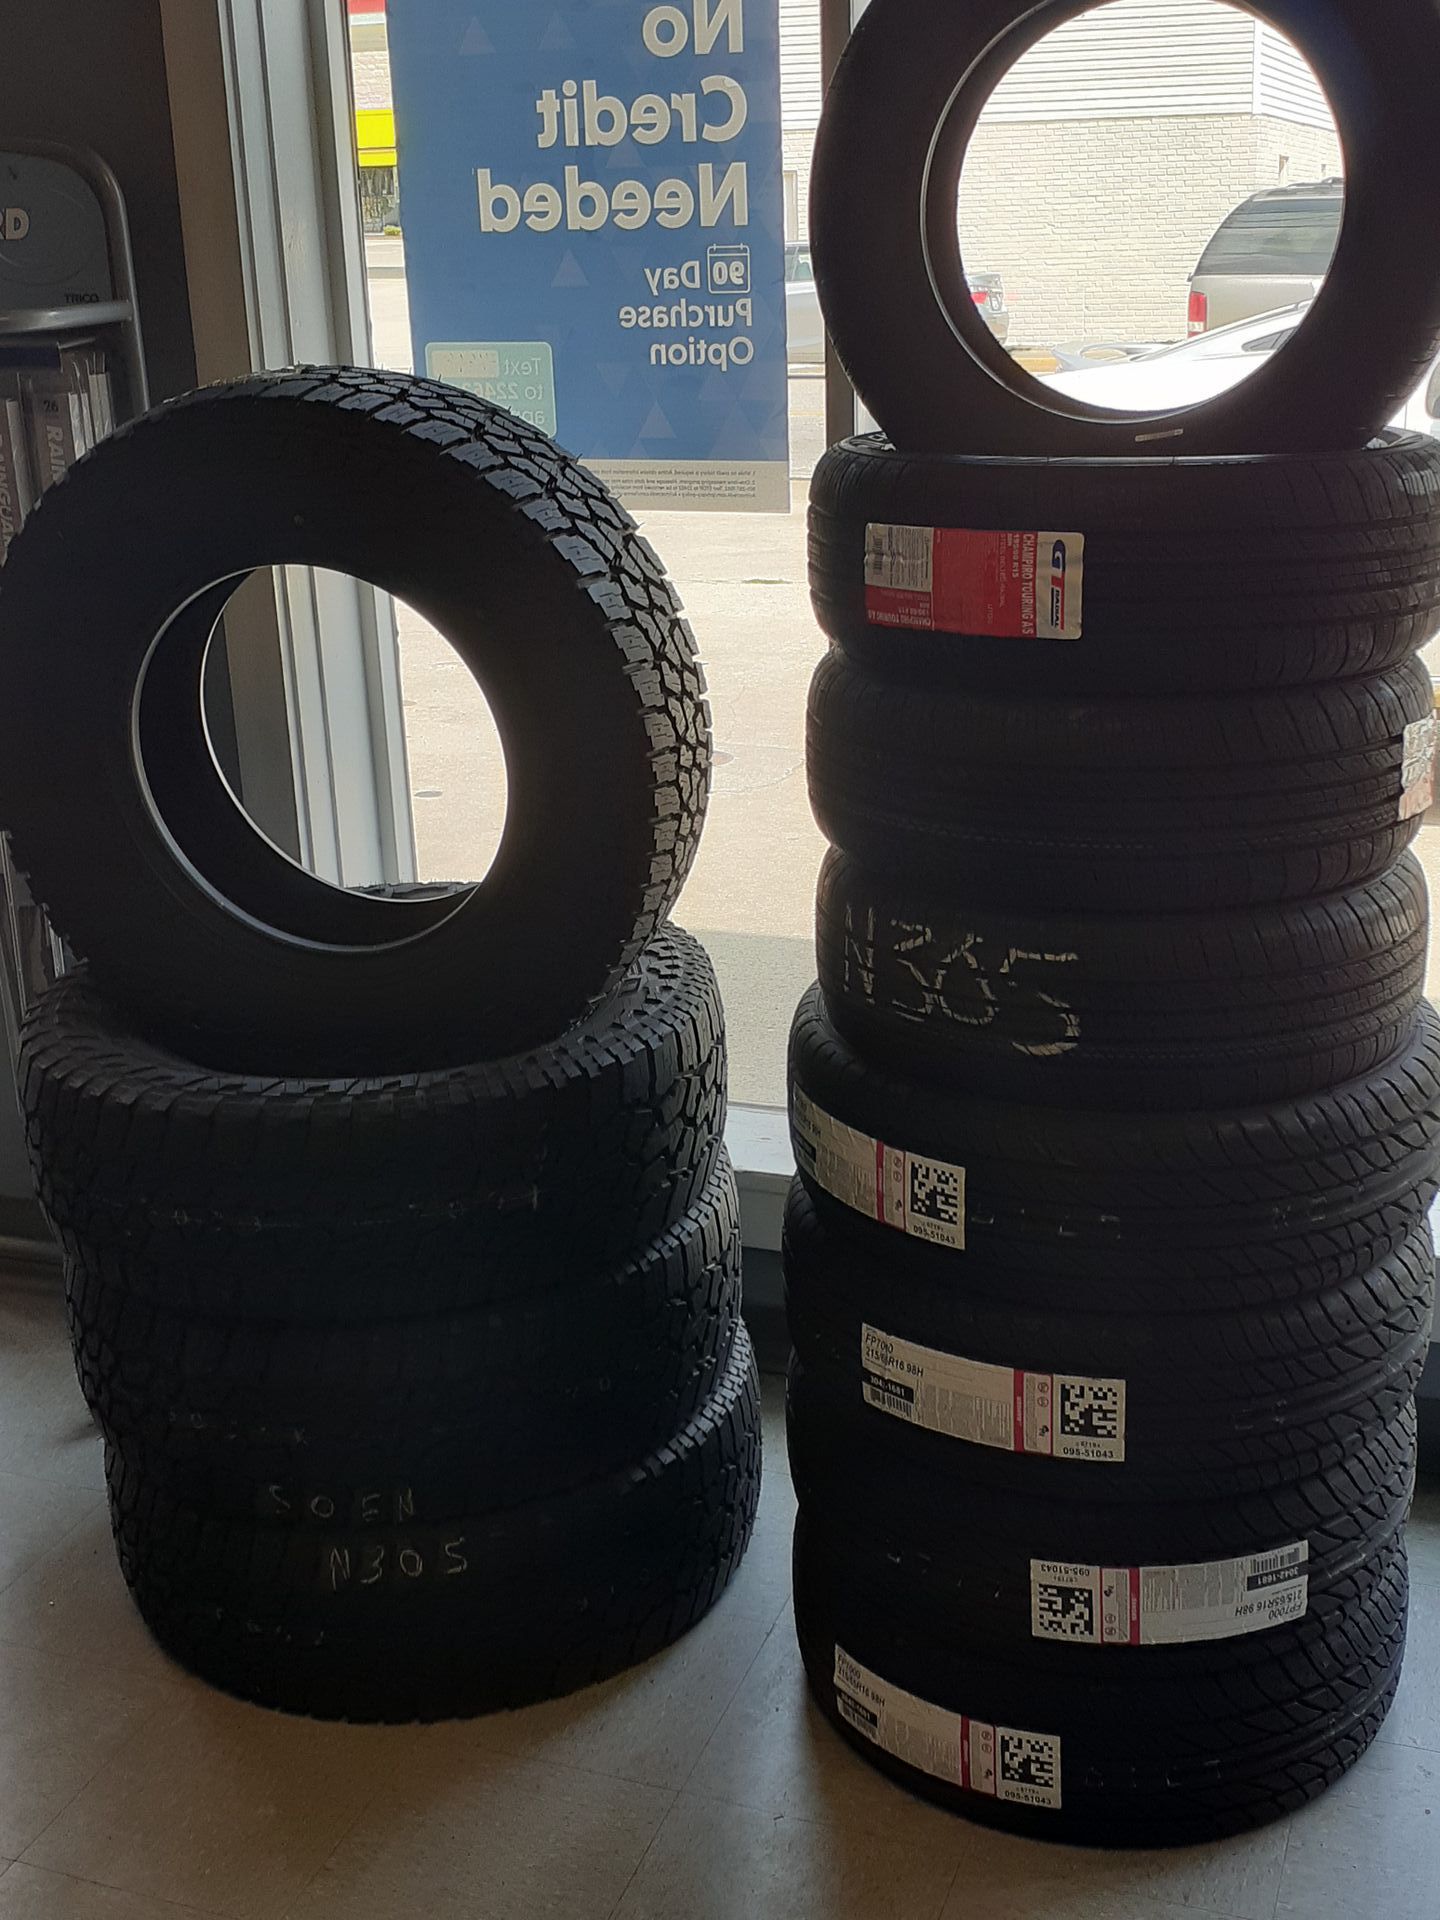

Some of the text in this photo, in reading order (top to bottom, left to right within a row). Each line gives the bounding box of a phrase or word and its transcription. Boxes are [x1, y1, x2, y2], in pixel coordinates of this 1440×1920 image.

[0, 207, 30, 241] D
[1022, 533, 1034, 580] CHAMPIRO
[1021, 582, 1034, 620] TOURING
[842, 903, 1082, 1057] N305
[913, 1225, 956, 1244] 095-51043
[906, 1363, 924, 1377] 98H
[1063, 1446, 1114, 1458] 095-51043
[329, 1536, 468, 1591] N305
[1040, 1564, 1090, 1577] 095-51043
[1234, 1603, 1255, 1617] 98H
[1268, 1601, 1302, 1620] FP7000
[1004, 1790, 1052, 1806] 095-51043
